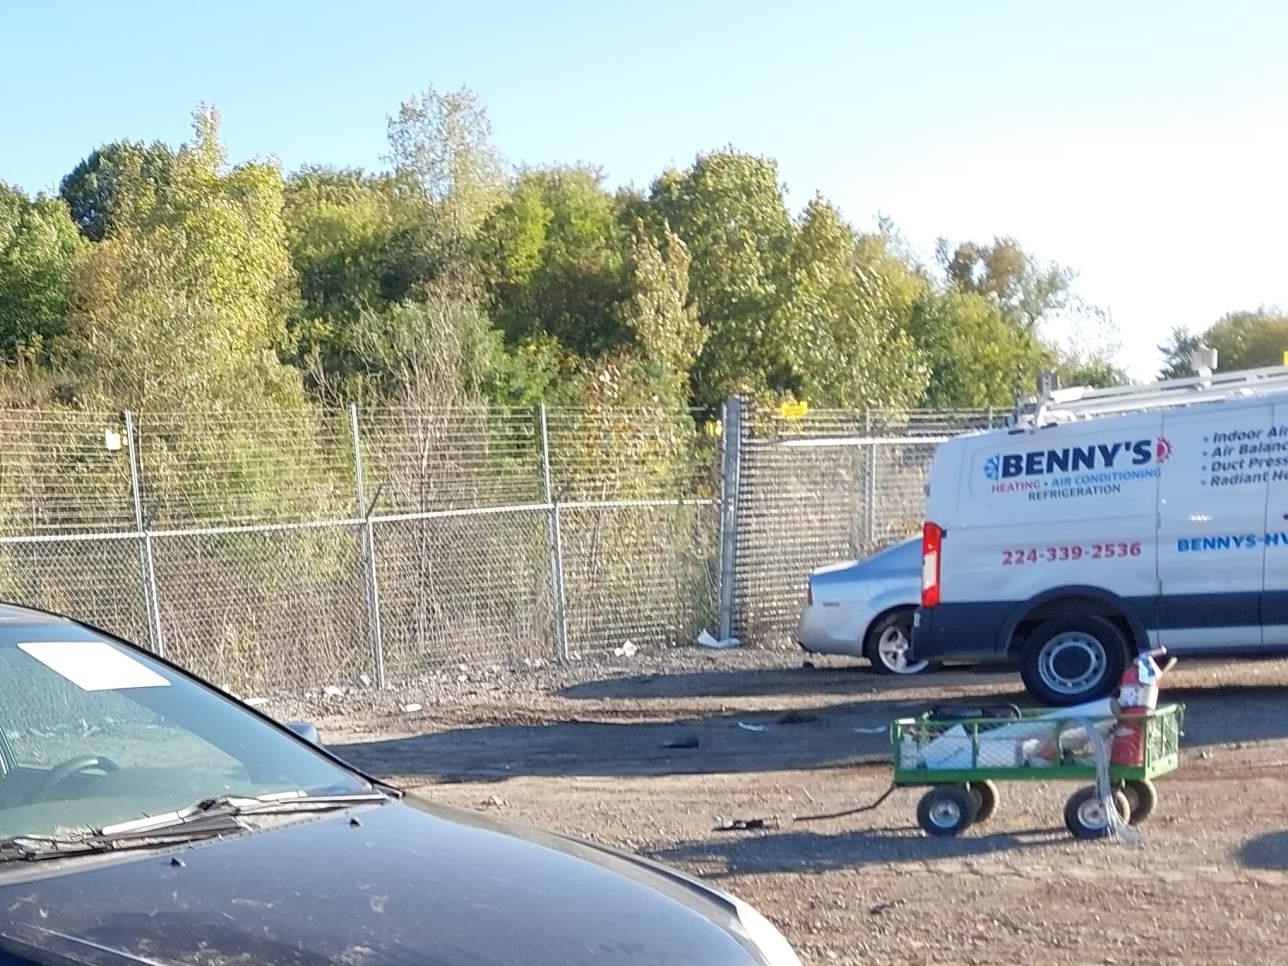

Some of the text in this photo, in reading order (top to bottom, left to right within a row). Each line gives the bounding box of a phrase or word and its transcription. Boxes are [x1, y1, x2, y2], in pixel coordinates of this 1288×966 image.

[1213, 430, 1264, 443] Indoor
[1001, 439, 1153, 479] BENNY'S
[1211, 446, 1235, 457] Air
[1211, 459, 1244, 472] Duct
[991, 467, 1162, 494] HEATING AIR CONDITIONING
[1210, 472, 1269, 487] Radiant
[1028, 483, 1121, 502] REFRIGERATION
[1002, 542, 1142, 566] 224-339-2536
